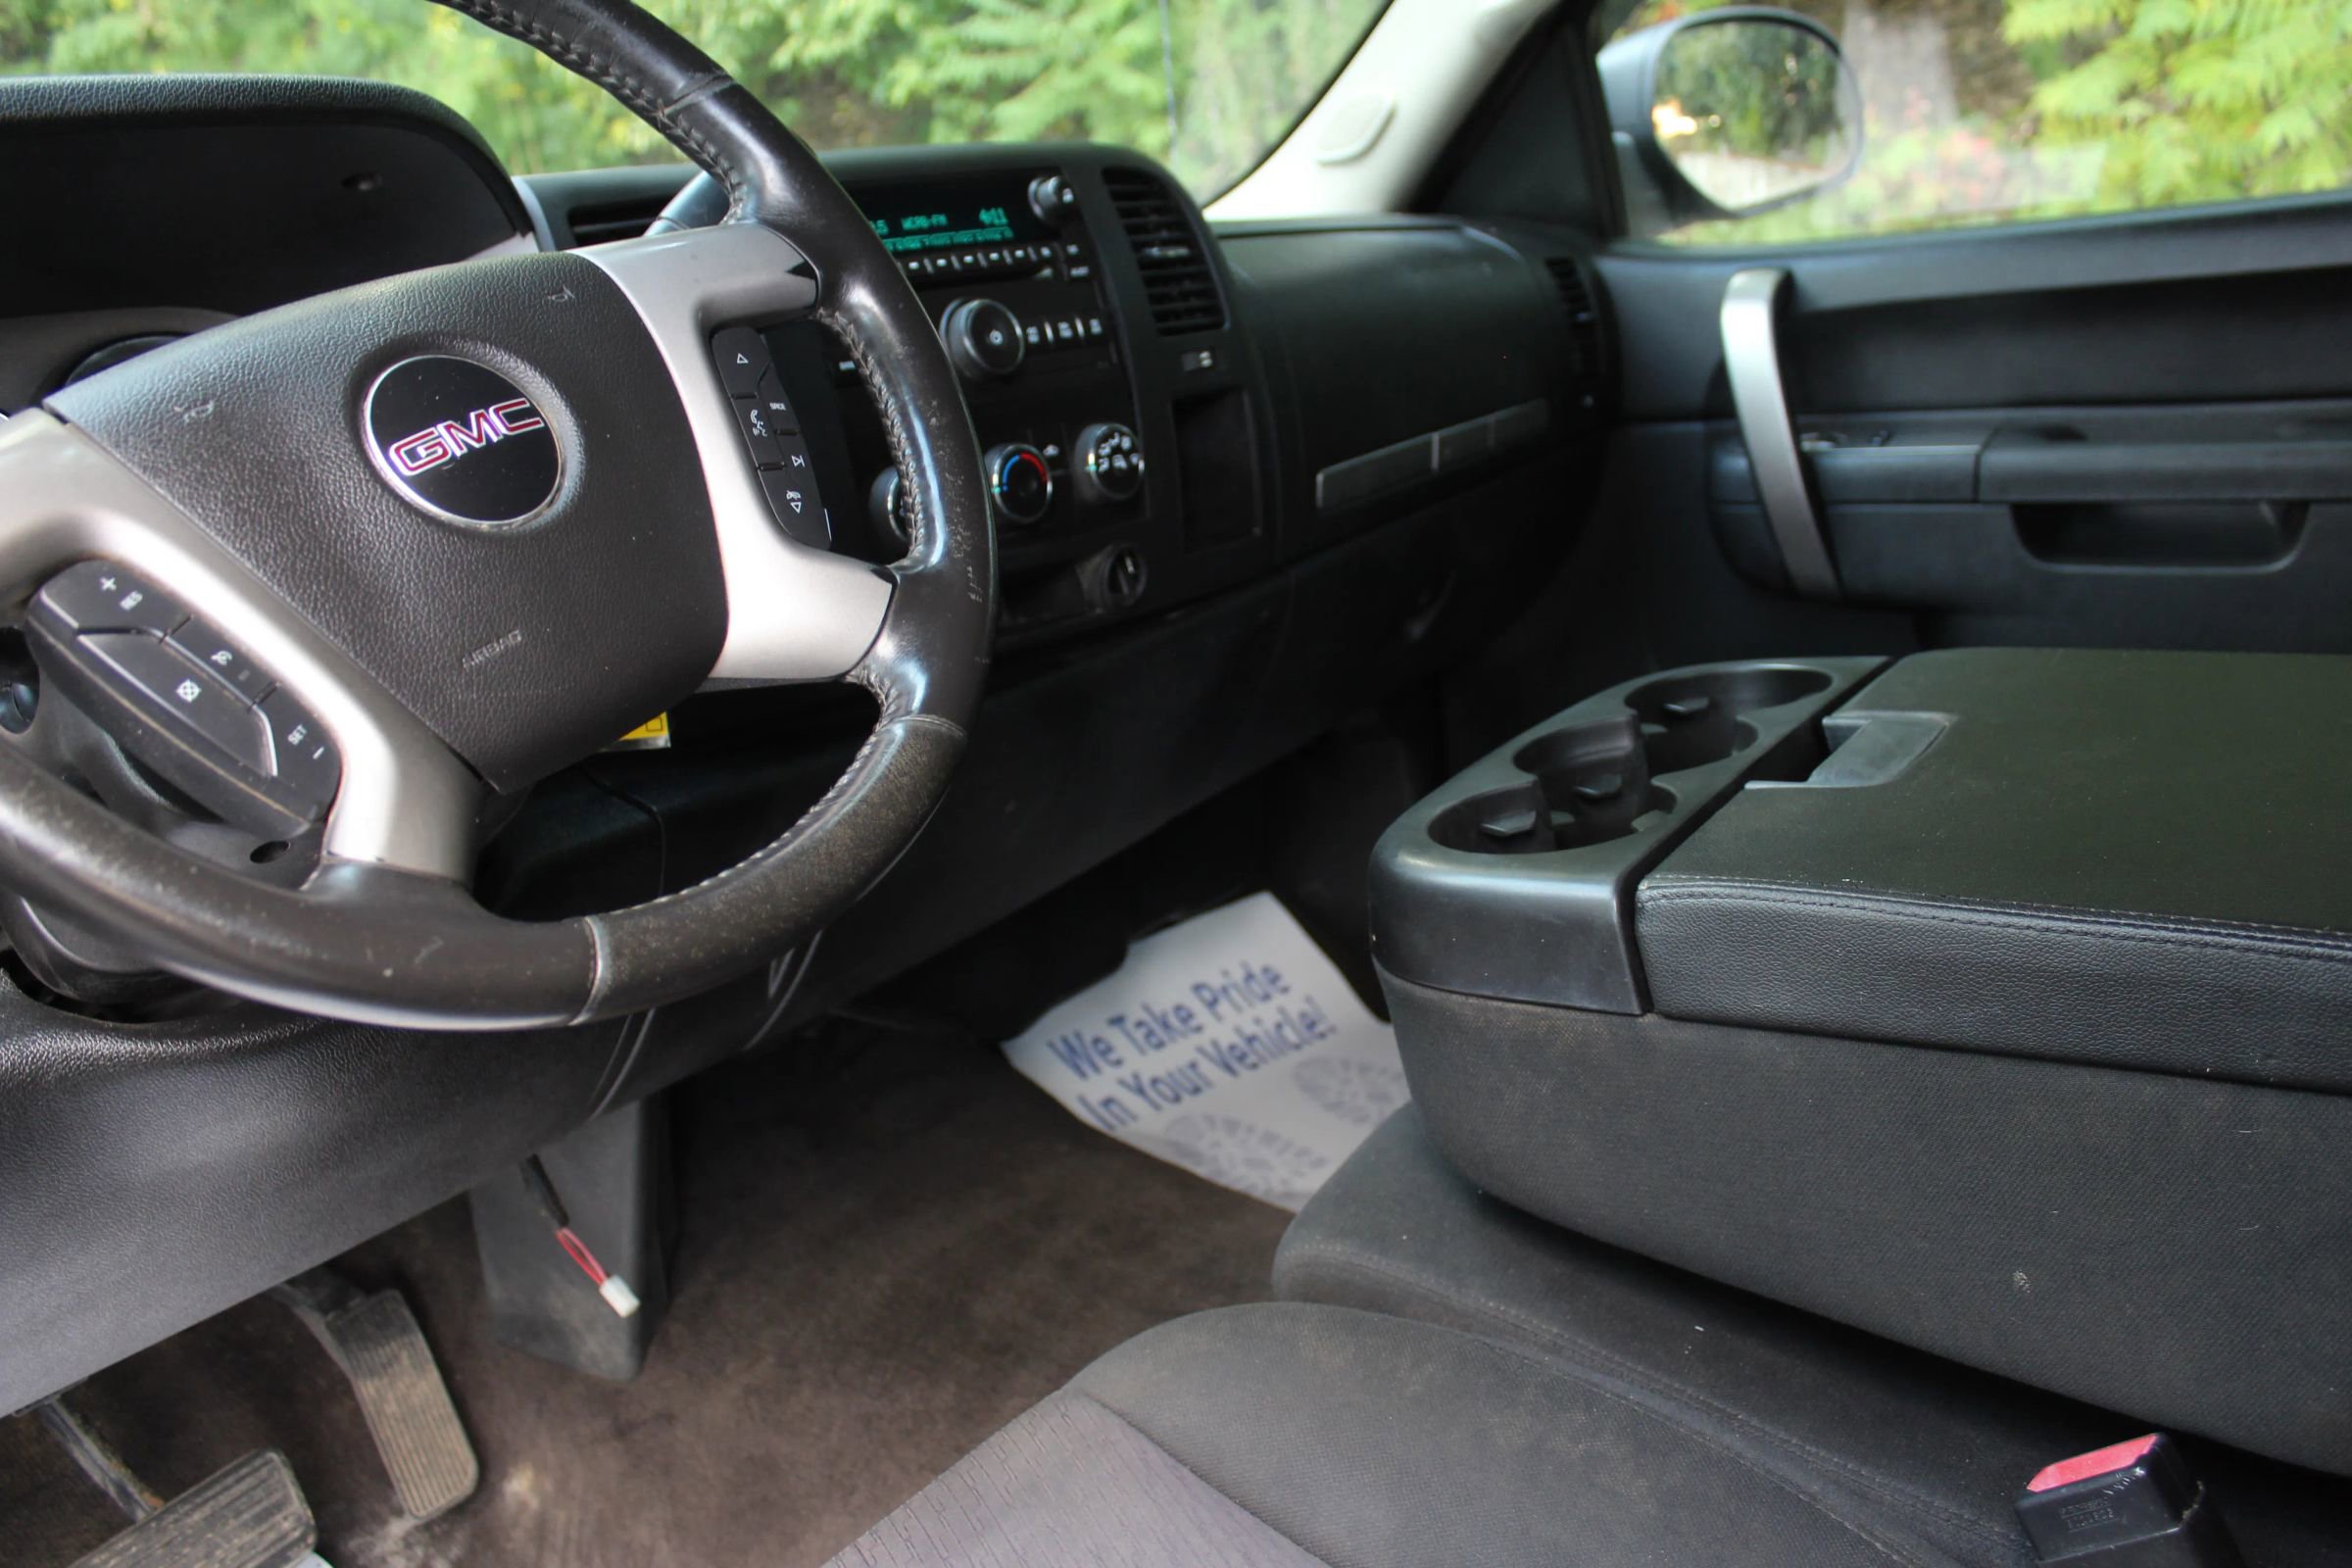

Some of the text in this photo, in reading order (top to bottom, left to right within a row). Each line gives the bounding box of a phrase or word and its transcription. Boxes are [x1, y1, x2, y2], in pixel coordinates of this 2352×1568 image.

[389, 397, 545, 476] GMC
[462, 629, 521, 673] AIRBAG
[287, 724, 307, 745] SET
[1048, 960, 1291, 1081] We Take Pride
[1076, 996, 1338, 1131] In Your Vehicle!
